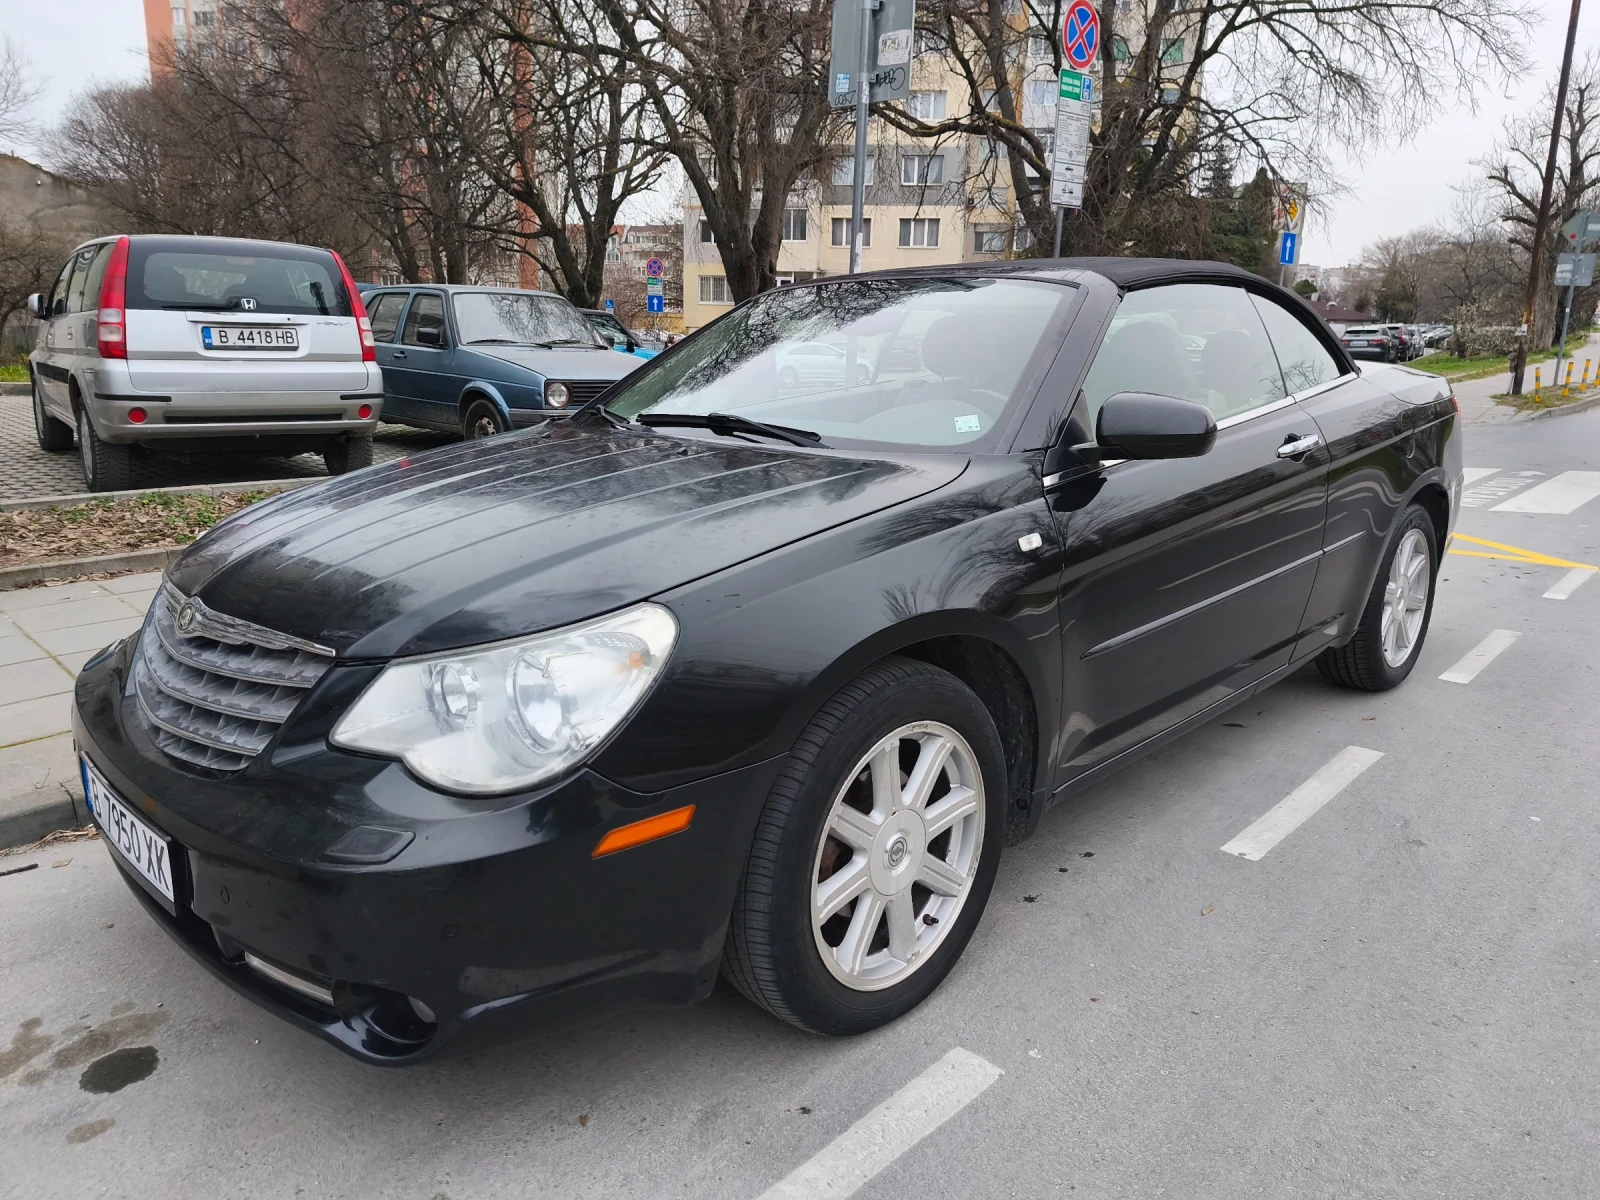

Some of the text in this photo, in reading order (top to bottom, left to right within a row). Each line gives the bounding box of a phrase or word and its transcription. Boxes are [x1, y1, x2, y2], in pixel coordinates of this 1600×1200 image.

[218, 330, 295, 344] B 4418 HB
[91, 776, 170, 893] B 7950 XK
